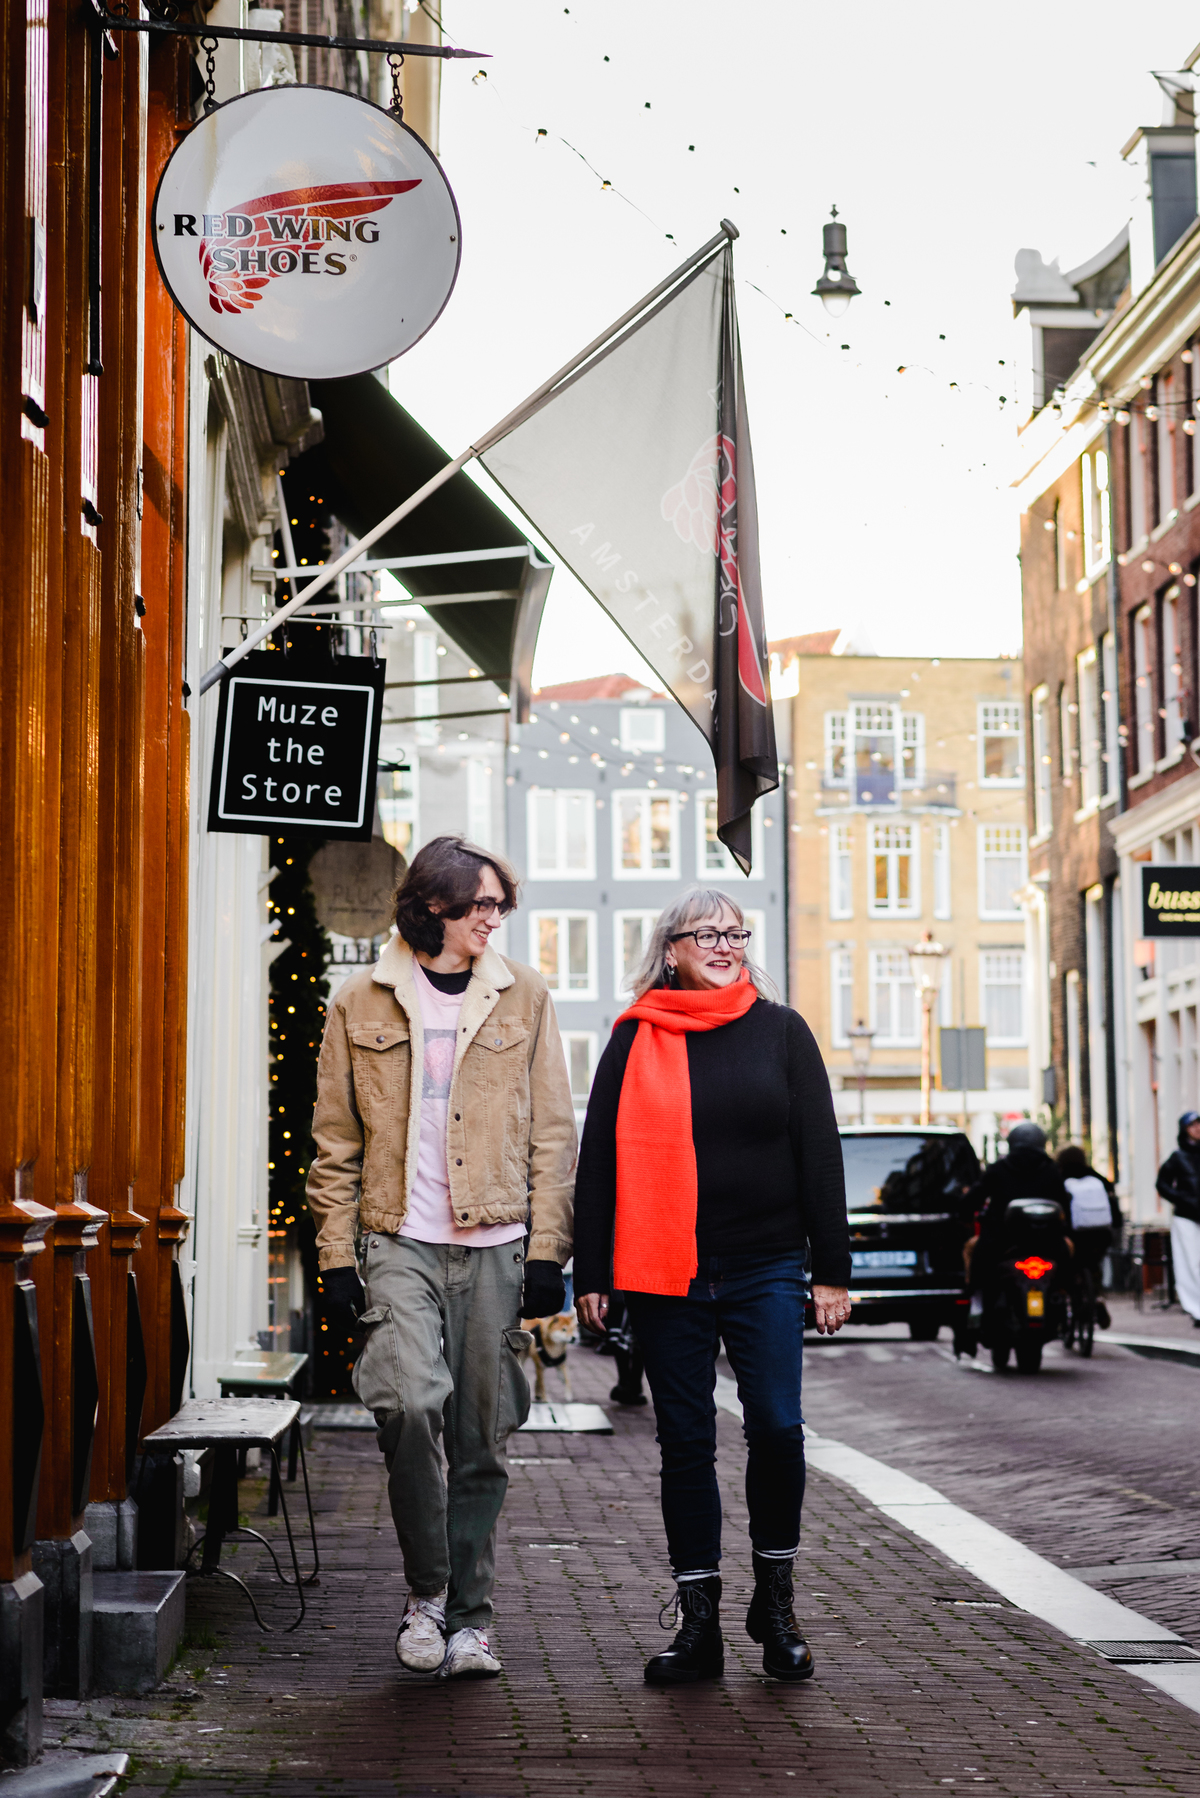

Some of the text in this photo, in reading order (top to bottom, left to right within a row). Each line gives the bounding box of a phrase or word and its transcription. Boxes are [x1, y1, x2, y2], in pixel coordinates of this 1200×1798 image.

[173, 214, 380, 243] RED WING
[569, 521, 718, 730] AMSTERDA
[257, 695, 339, 727] Muze
[267, 737, 325, 766] the
[241, 773, 343, 806] Store
